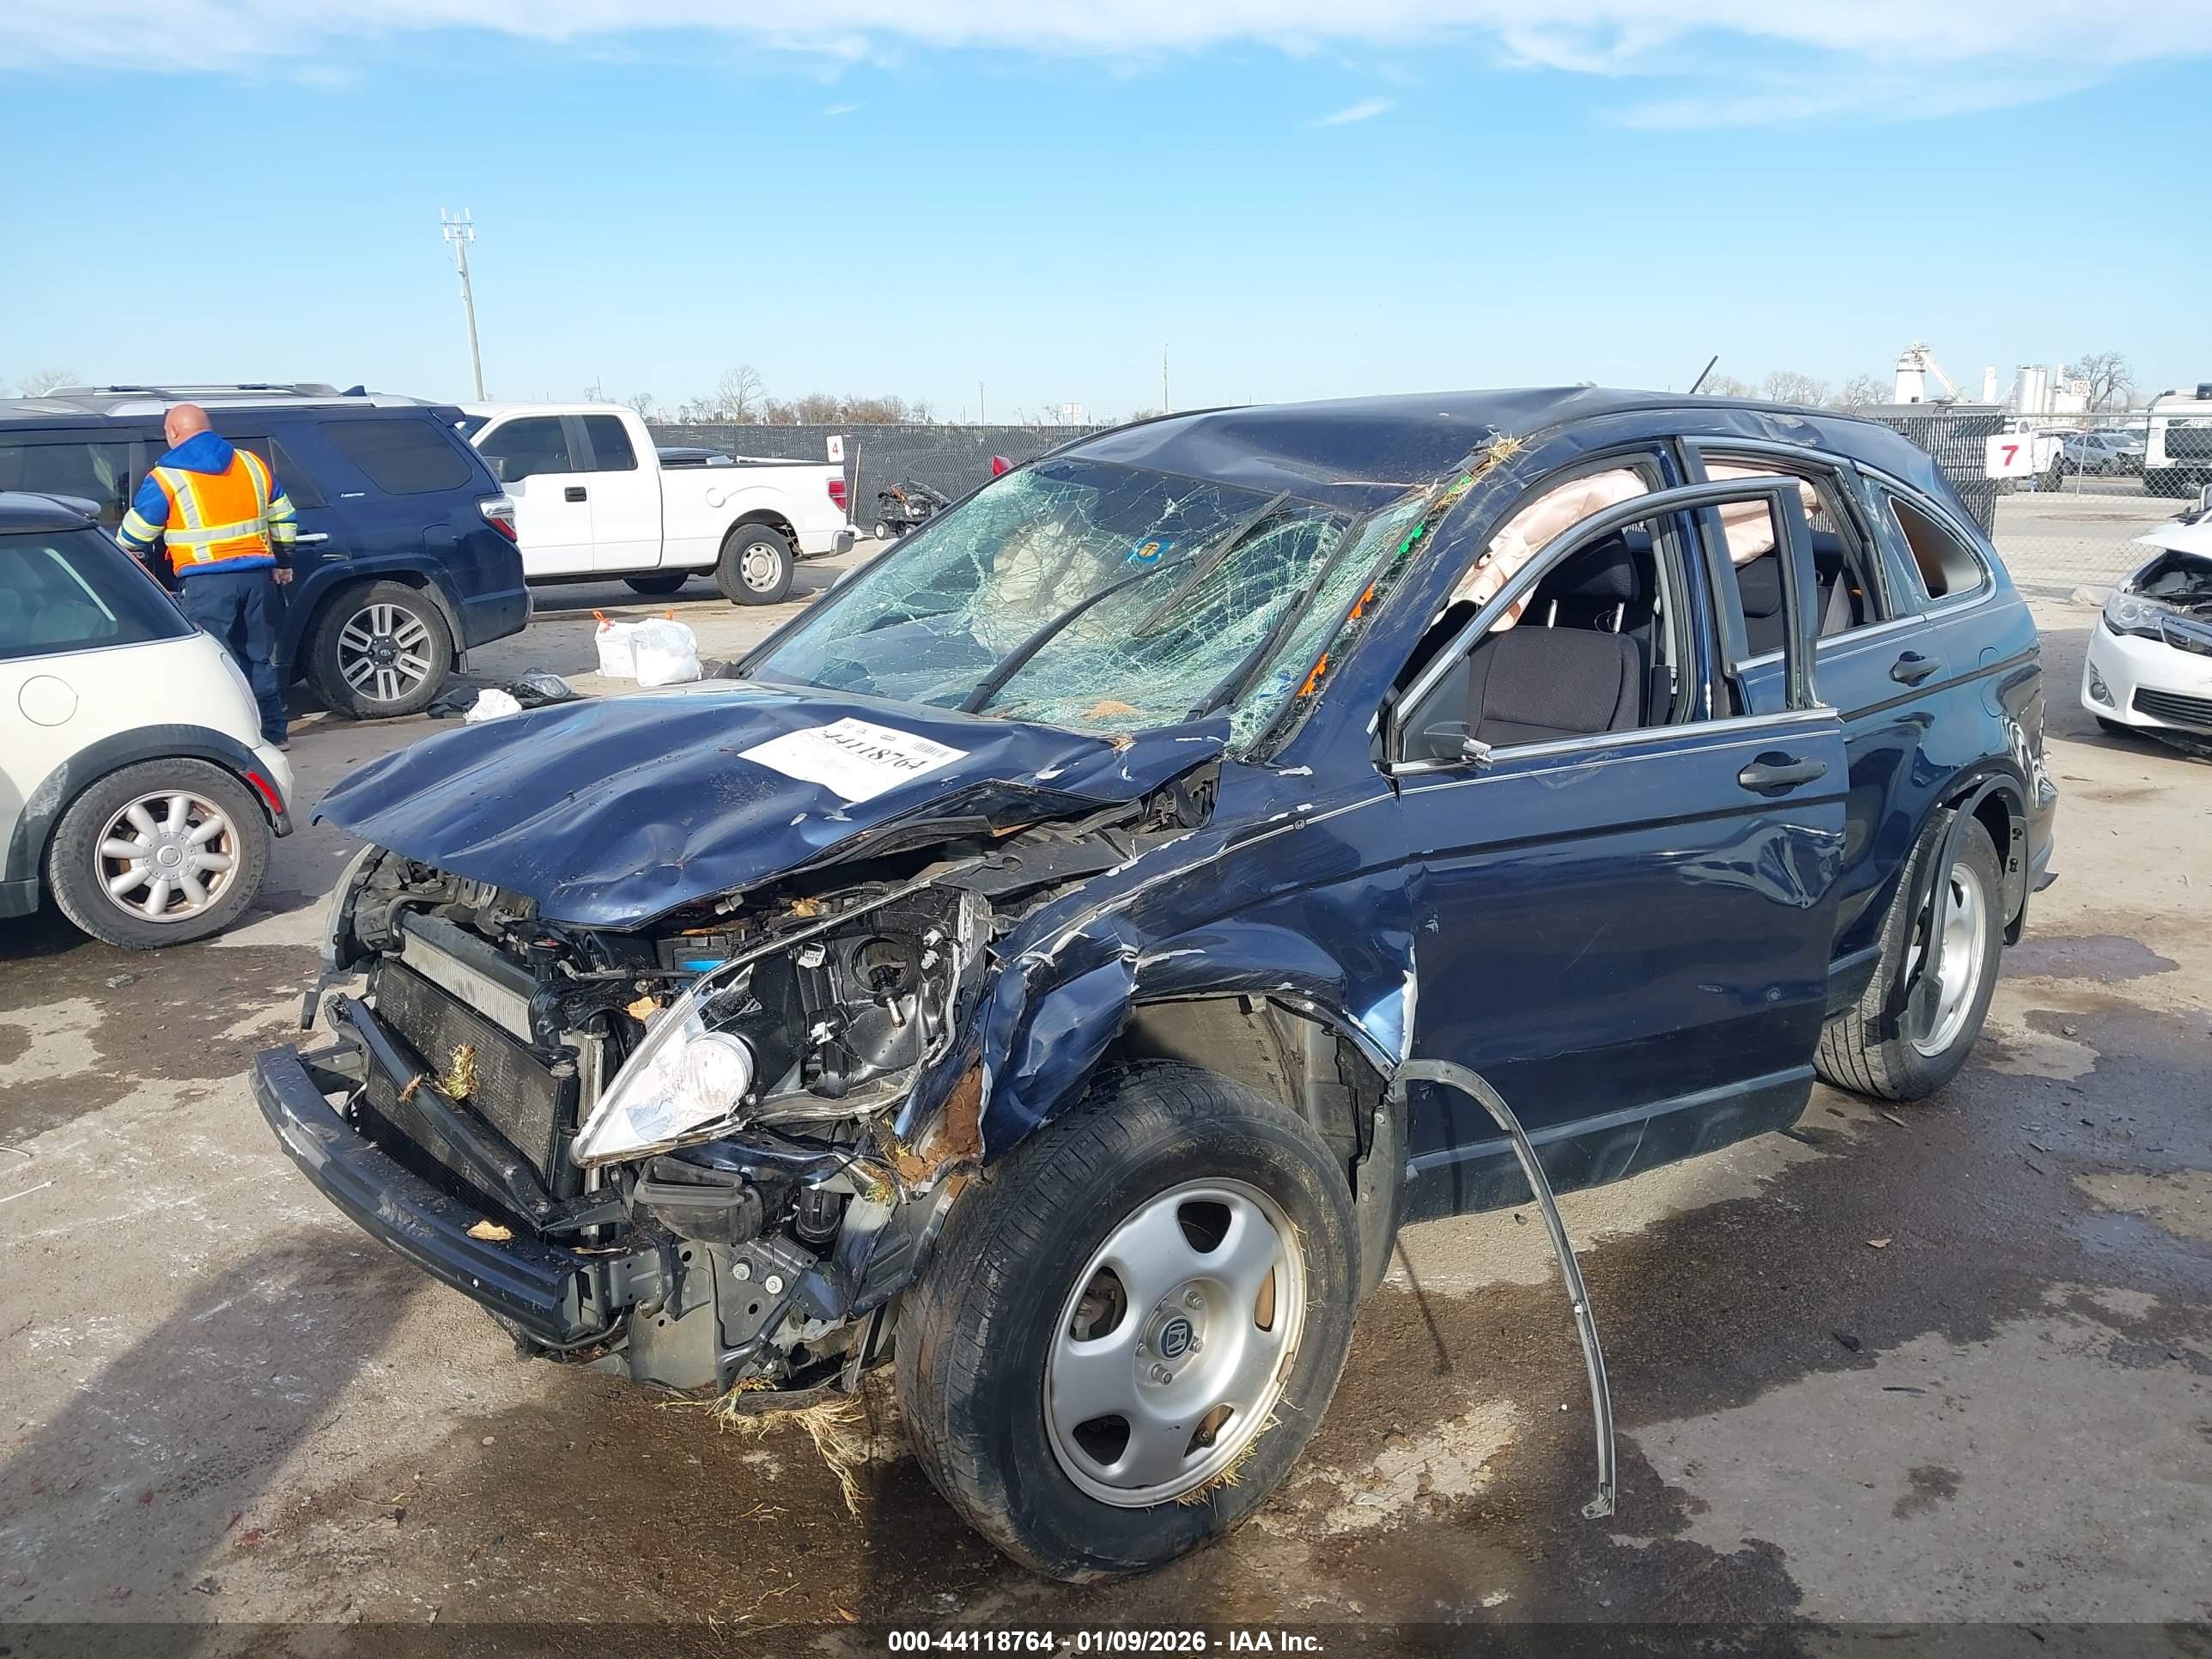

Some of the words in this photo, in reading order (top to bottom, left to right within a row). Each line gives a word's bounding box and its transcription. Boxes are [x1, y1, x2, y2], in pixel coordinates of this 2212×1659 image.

[2074, 382, 2088, 395] 150
[832, 441, 839, 456] 4
[2001, 445, 2020, 466] 7
[823, 731, 928, 769] 44118764
